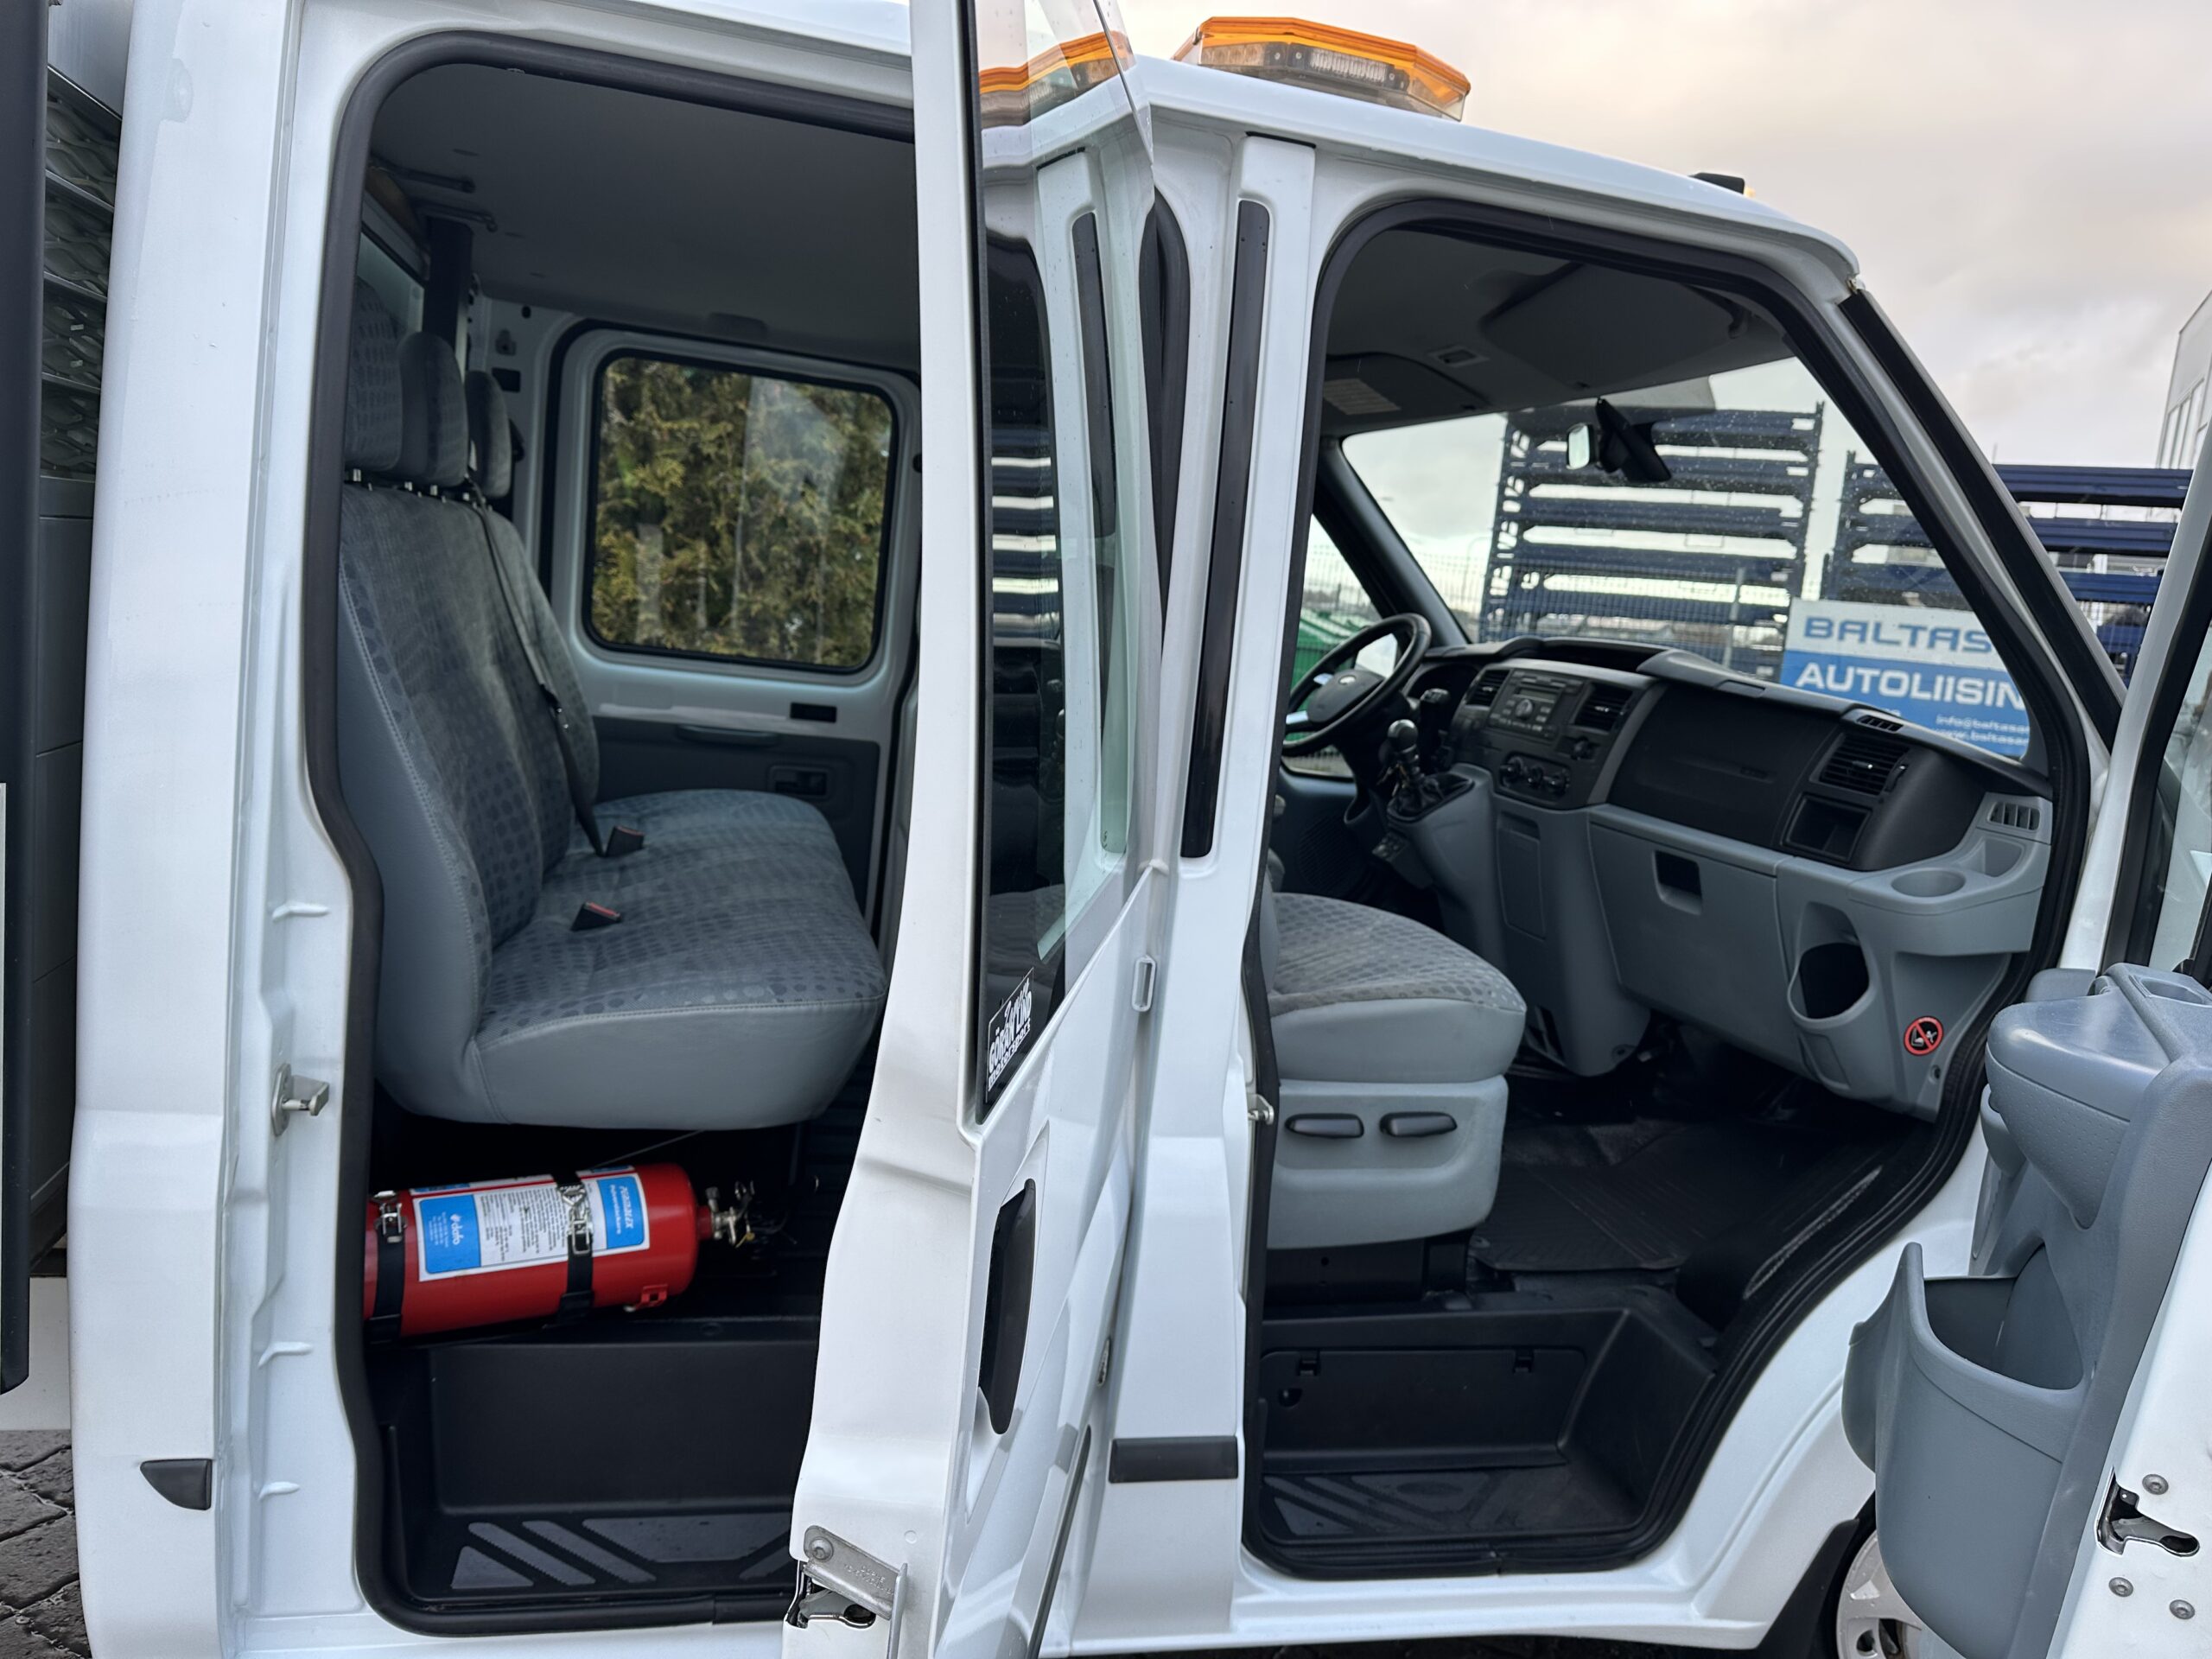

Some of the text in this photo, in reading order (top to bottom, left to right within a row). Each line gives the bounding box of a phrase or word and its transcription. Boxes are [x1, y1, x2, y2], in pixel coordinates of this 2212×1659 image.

[1804, 616, 1993, 653] BALTAS
[1015, 990, 1032, 1034] LIND
[451, 1223, 464, 1245] dafo
